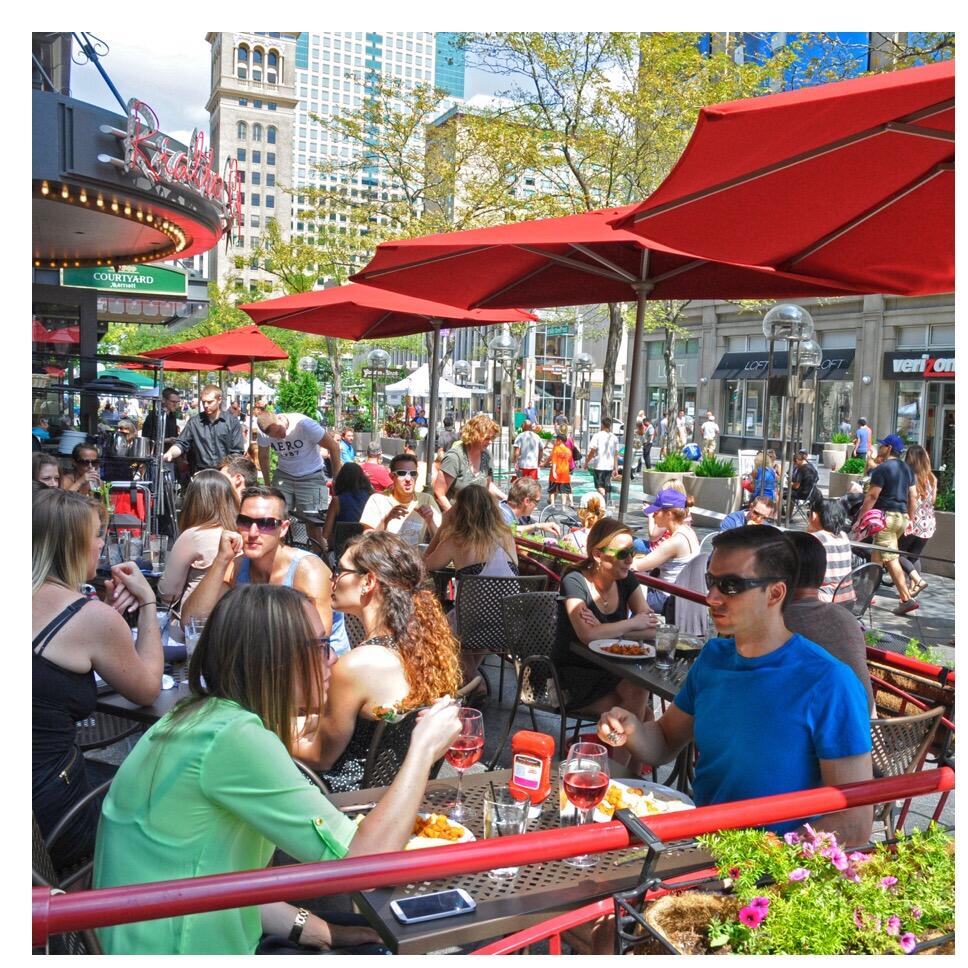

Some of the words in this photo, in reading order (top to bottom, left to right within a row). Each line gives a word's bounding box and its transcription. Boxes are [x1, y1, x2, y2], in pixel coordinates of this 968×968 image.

[93, 272, 154, 284] COURTYARD
[744, 360, 769, 371] LOFT
[893, 353, 955, 377] verizon
[271, 440, 304, 451] AERO
